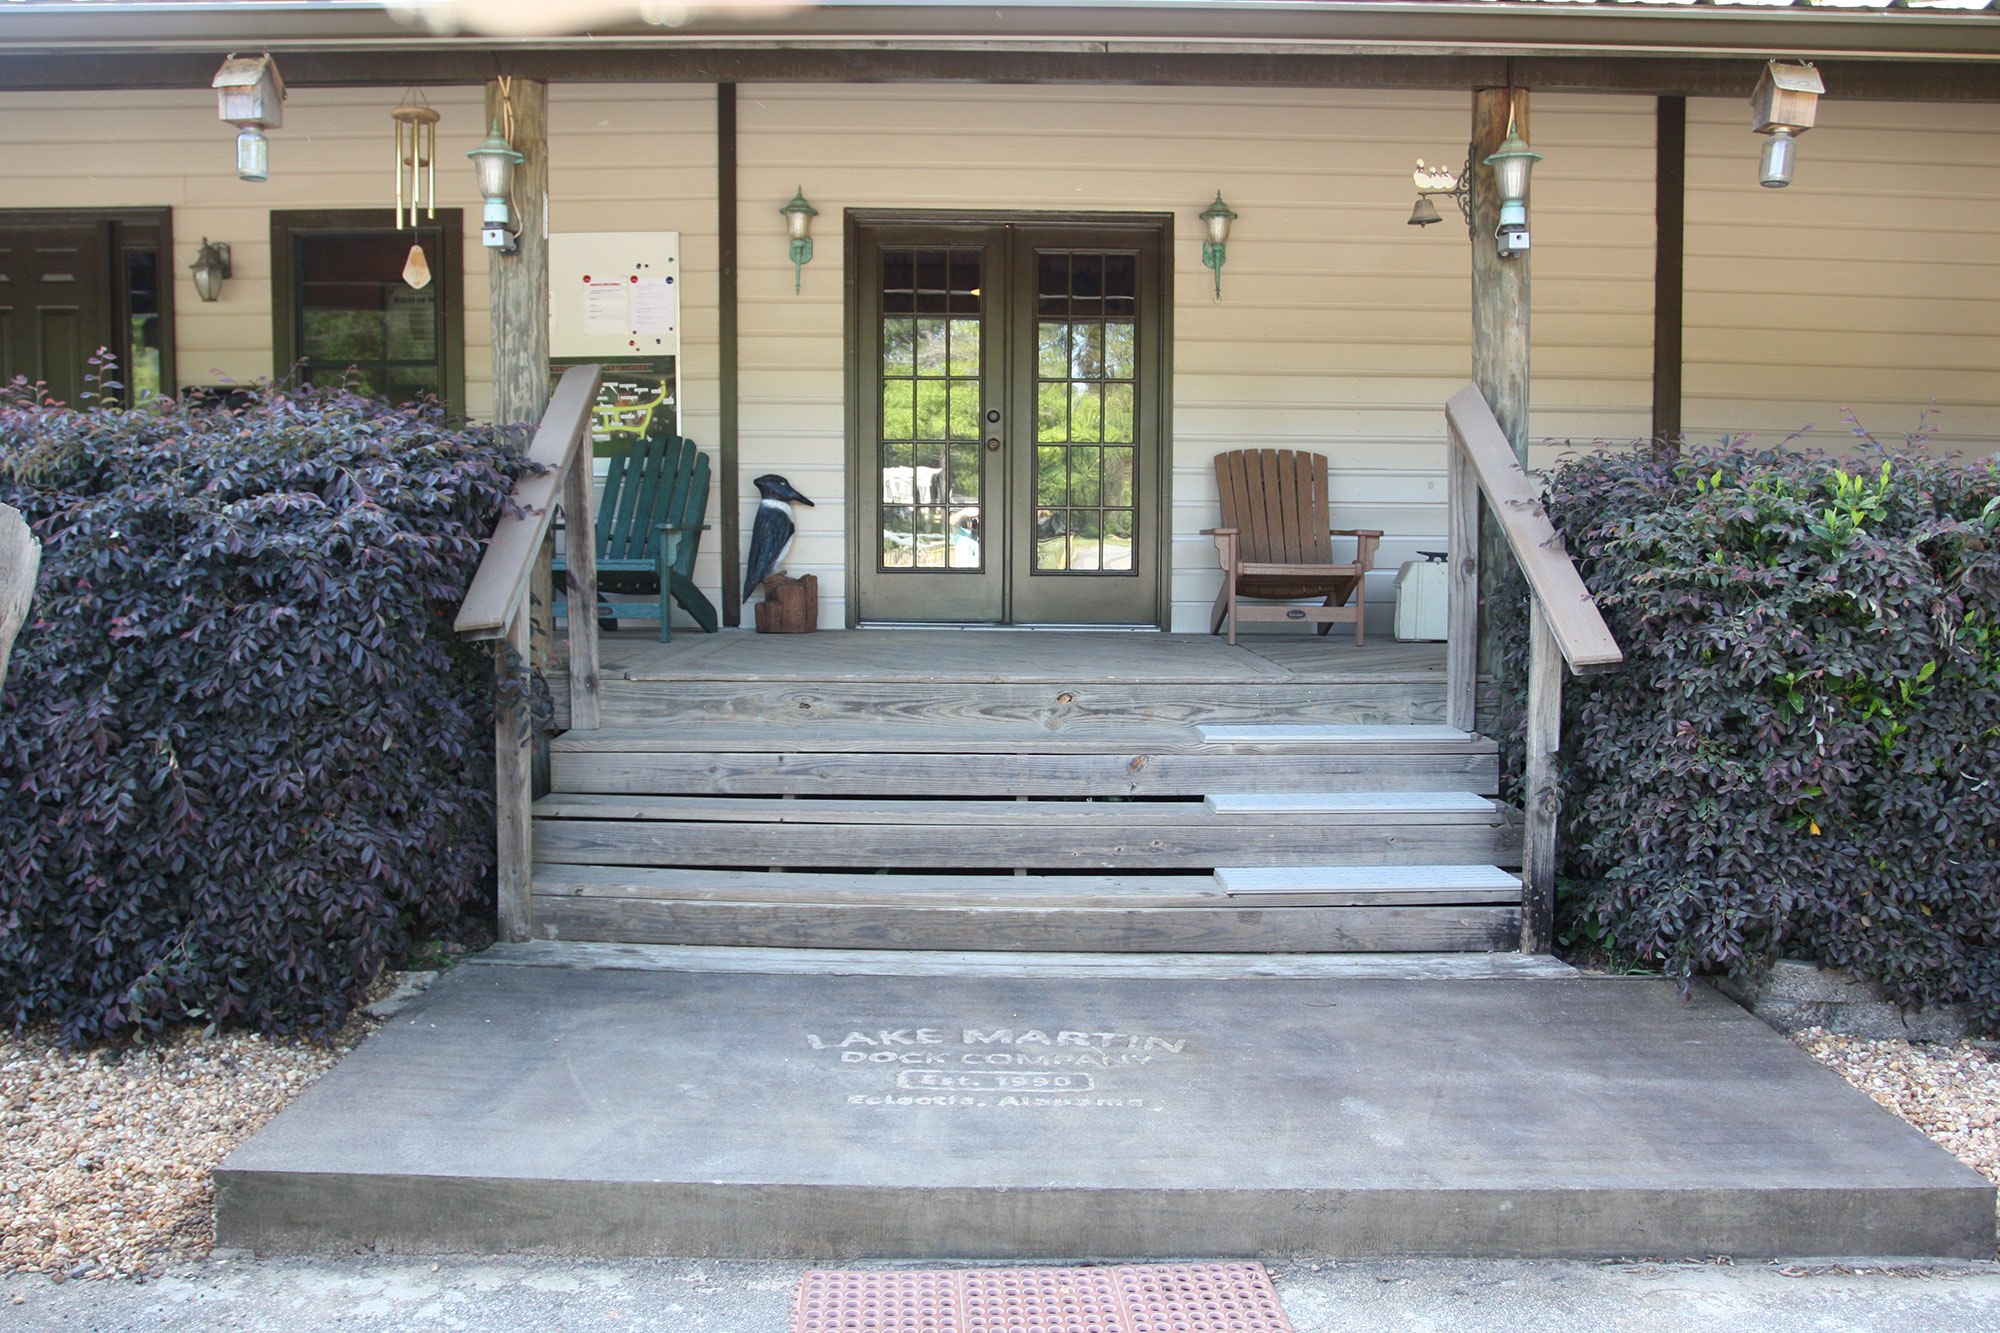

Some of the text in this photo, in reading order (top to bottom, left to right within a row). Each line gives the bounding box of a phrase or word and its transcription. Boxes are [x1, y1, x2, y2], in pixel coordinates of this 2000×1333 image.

[807, 1028, 1186, 1053] LAKE MARTIN
[841, 1051, 1152, 1066] DOCK COMPANY
[920, 1075, 1072, 1087] Est. 1990
[998, 1095, 1144, 1107] Alabama
